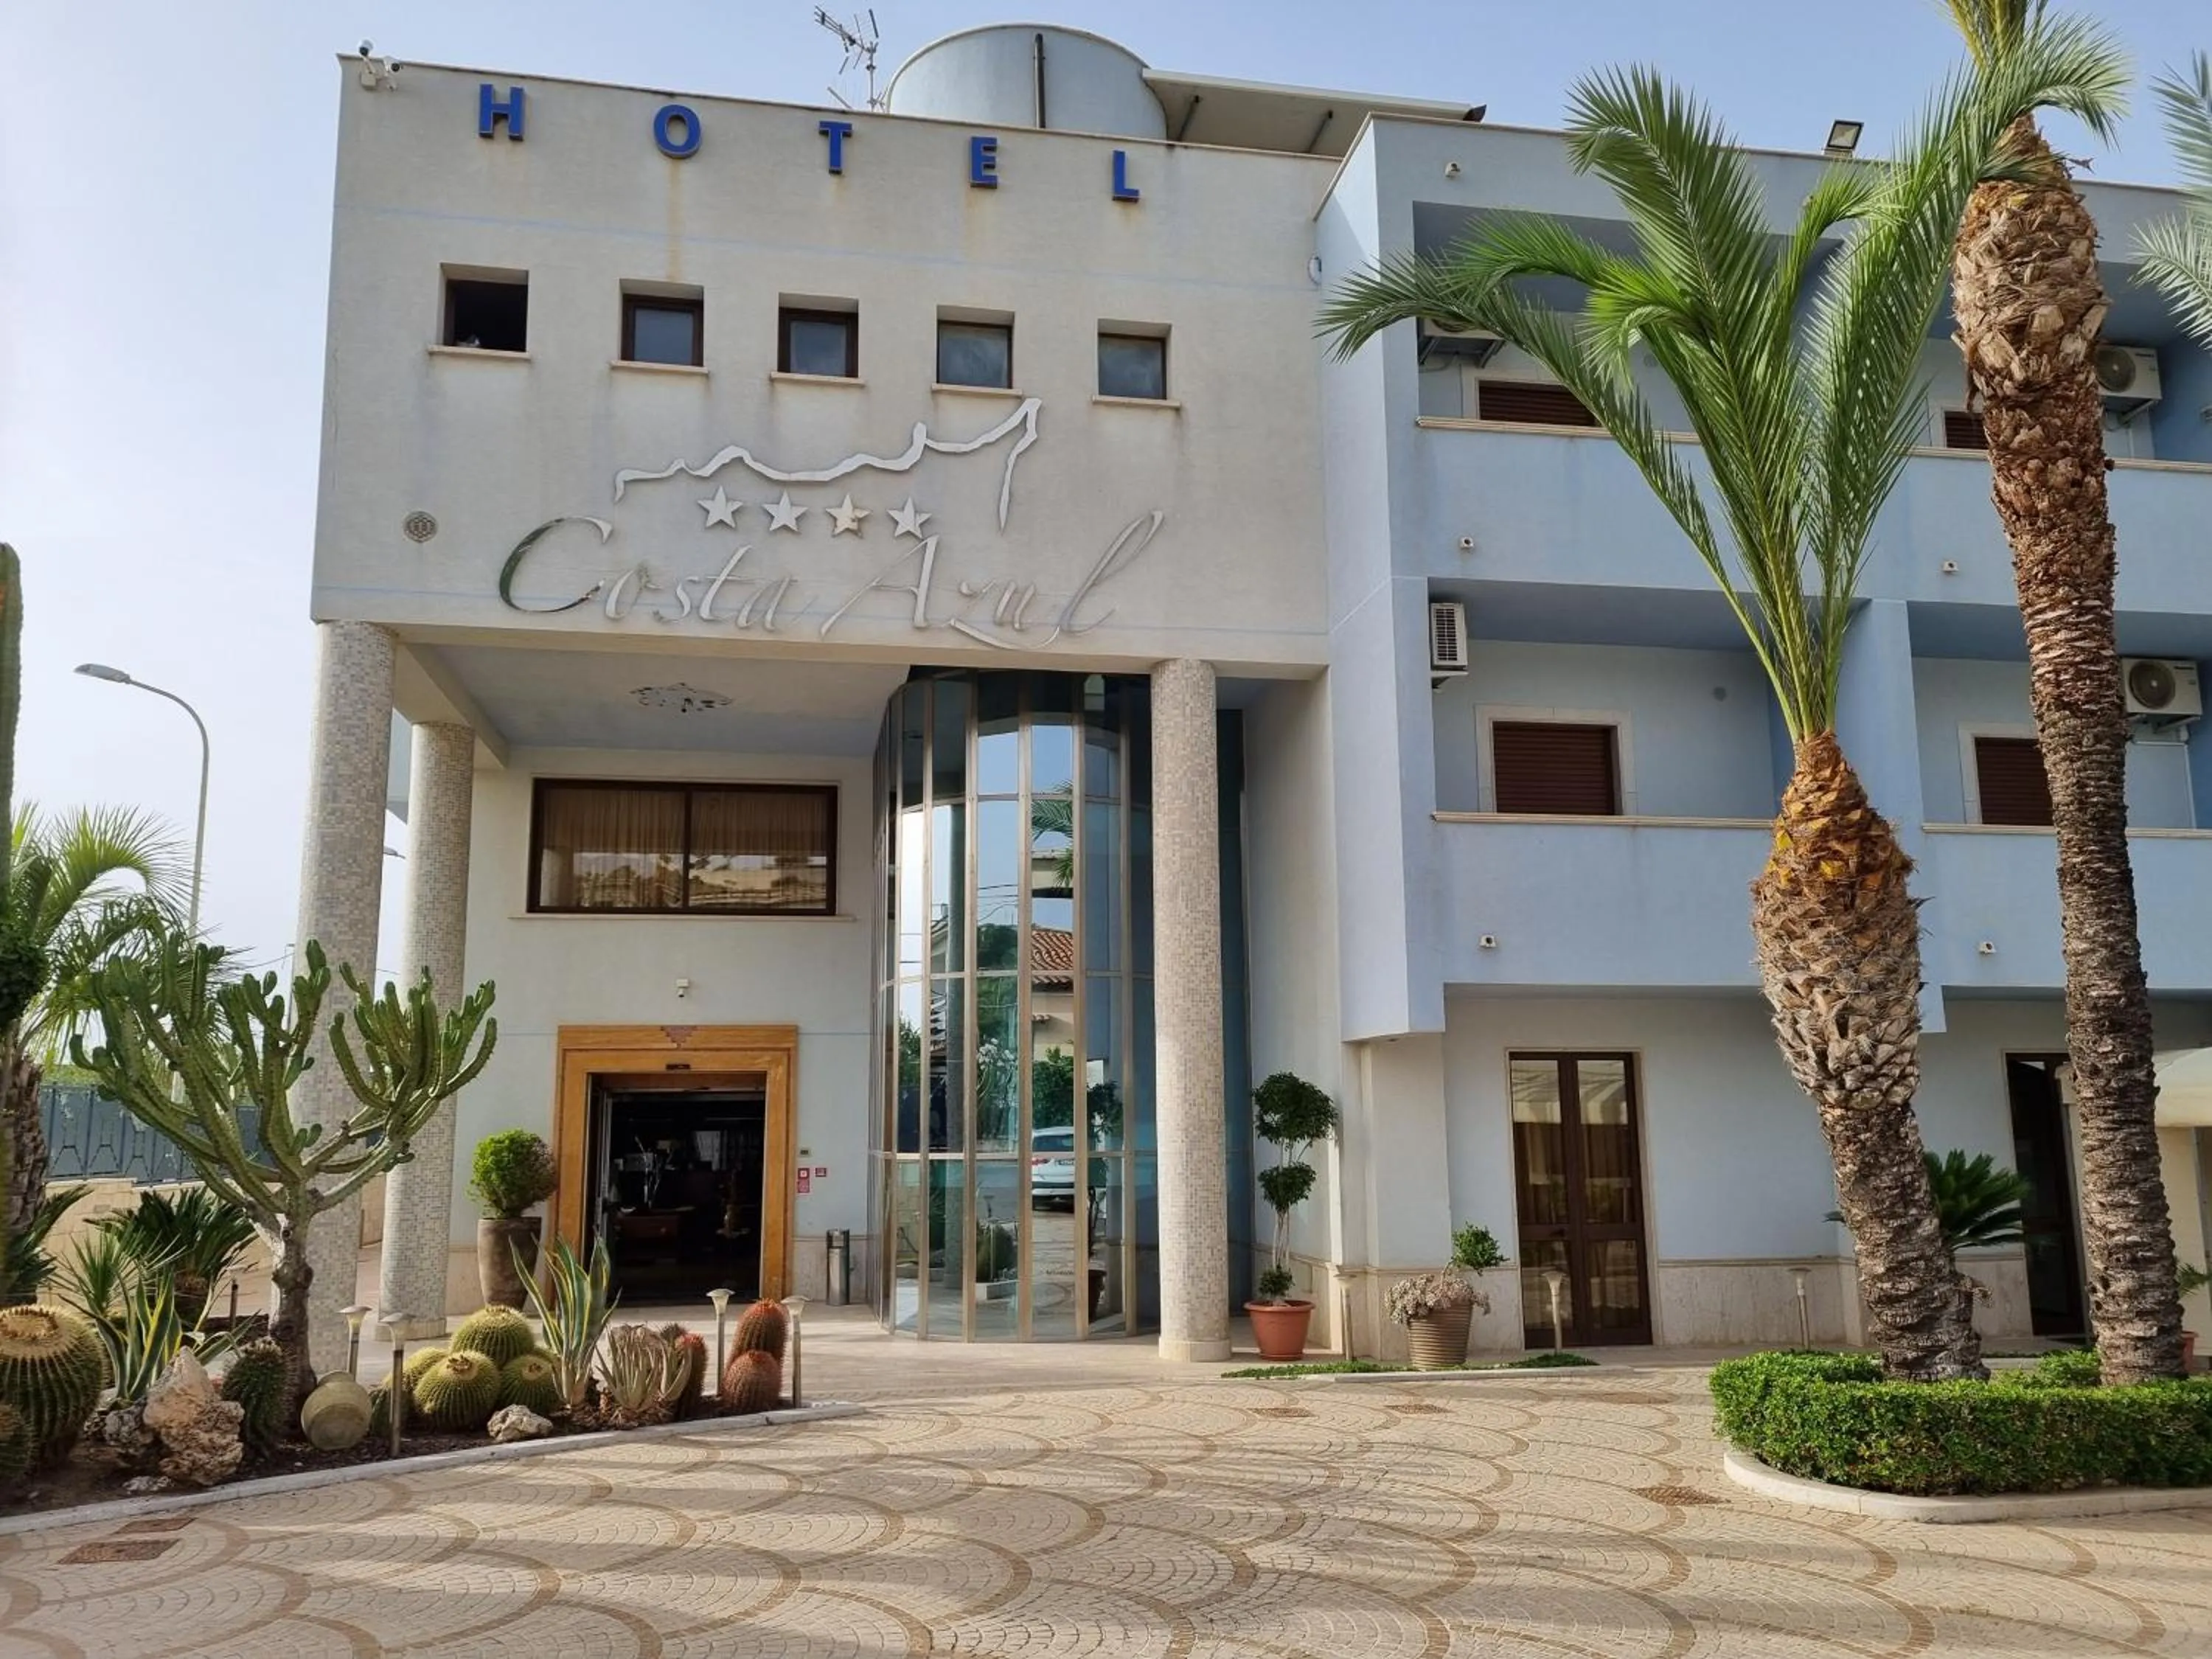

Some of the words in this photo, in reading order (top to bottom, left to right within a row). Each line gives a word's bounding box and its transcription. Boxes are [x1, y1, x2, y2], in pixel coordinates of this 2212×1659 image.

[478, 83, 1141, 202] HOTEL
[498, 516, 815, 633] Costa
[820, 510, 1165, 650] Azul
